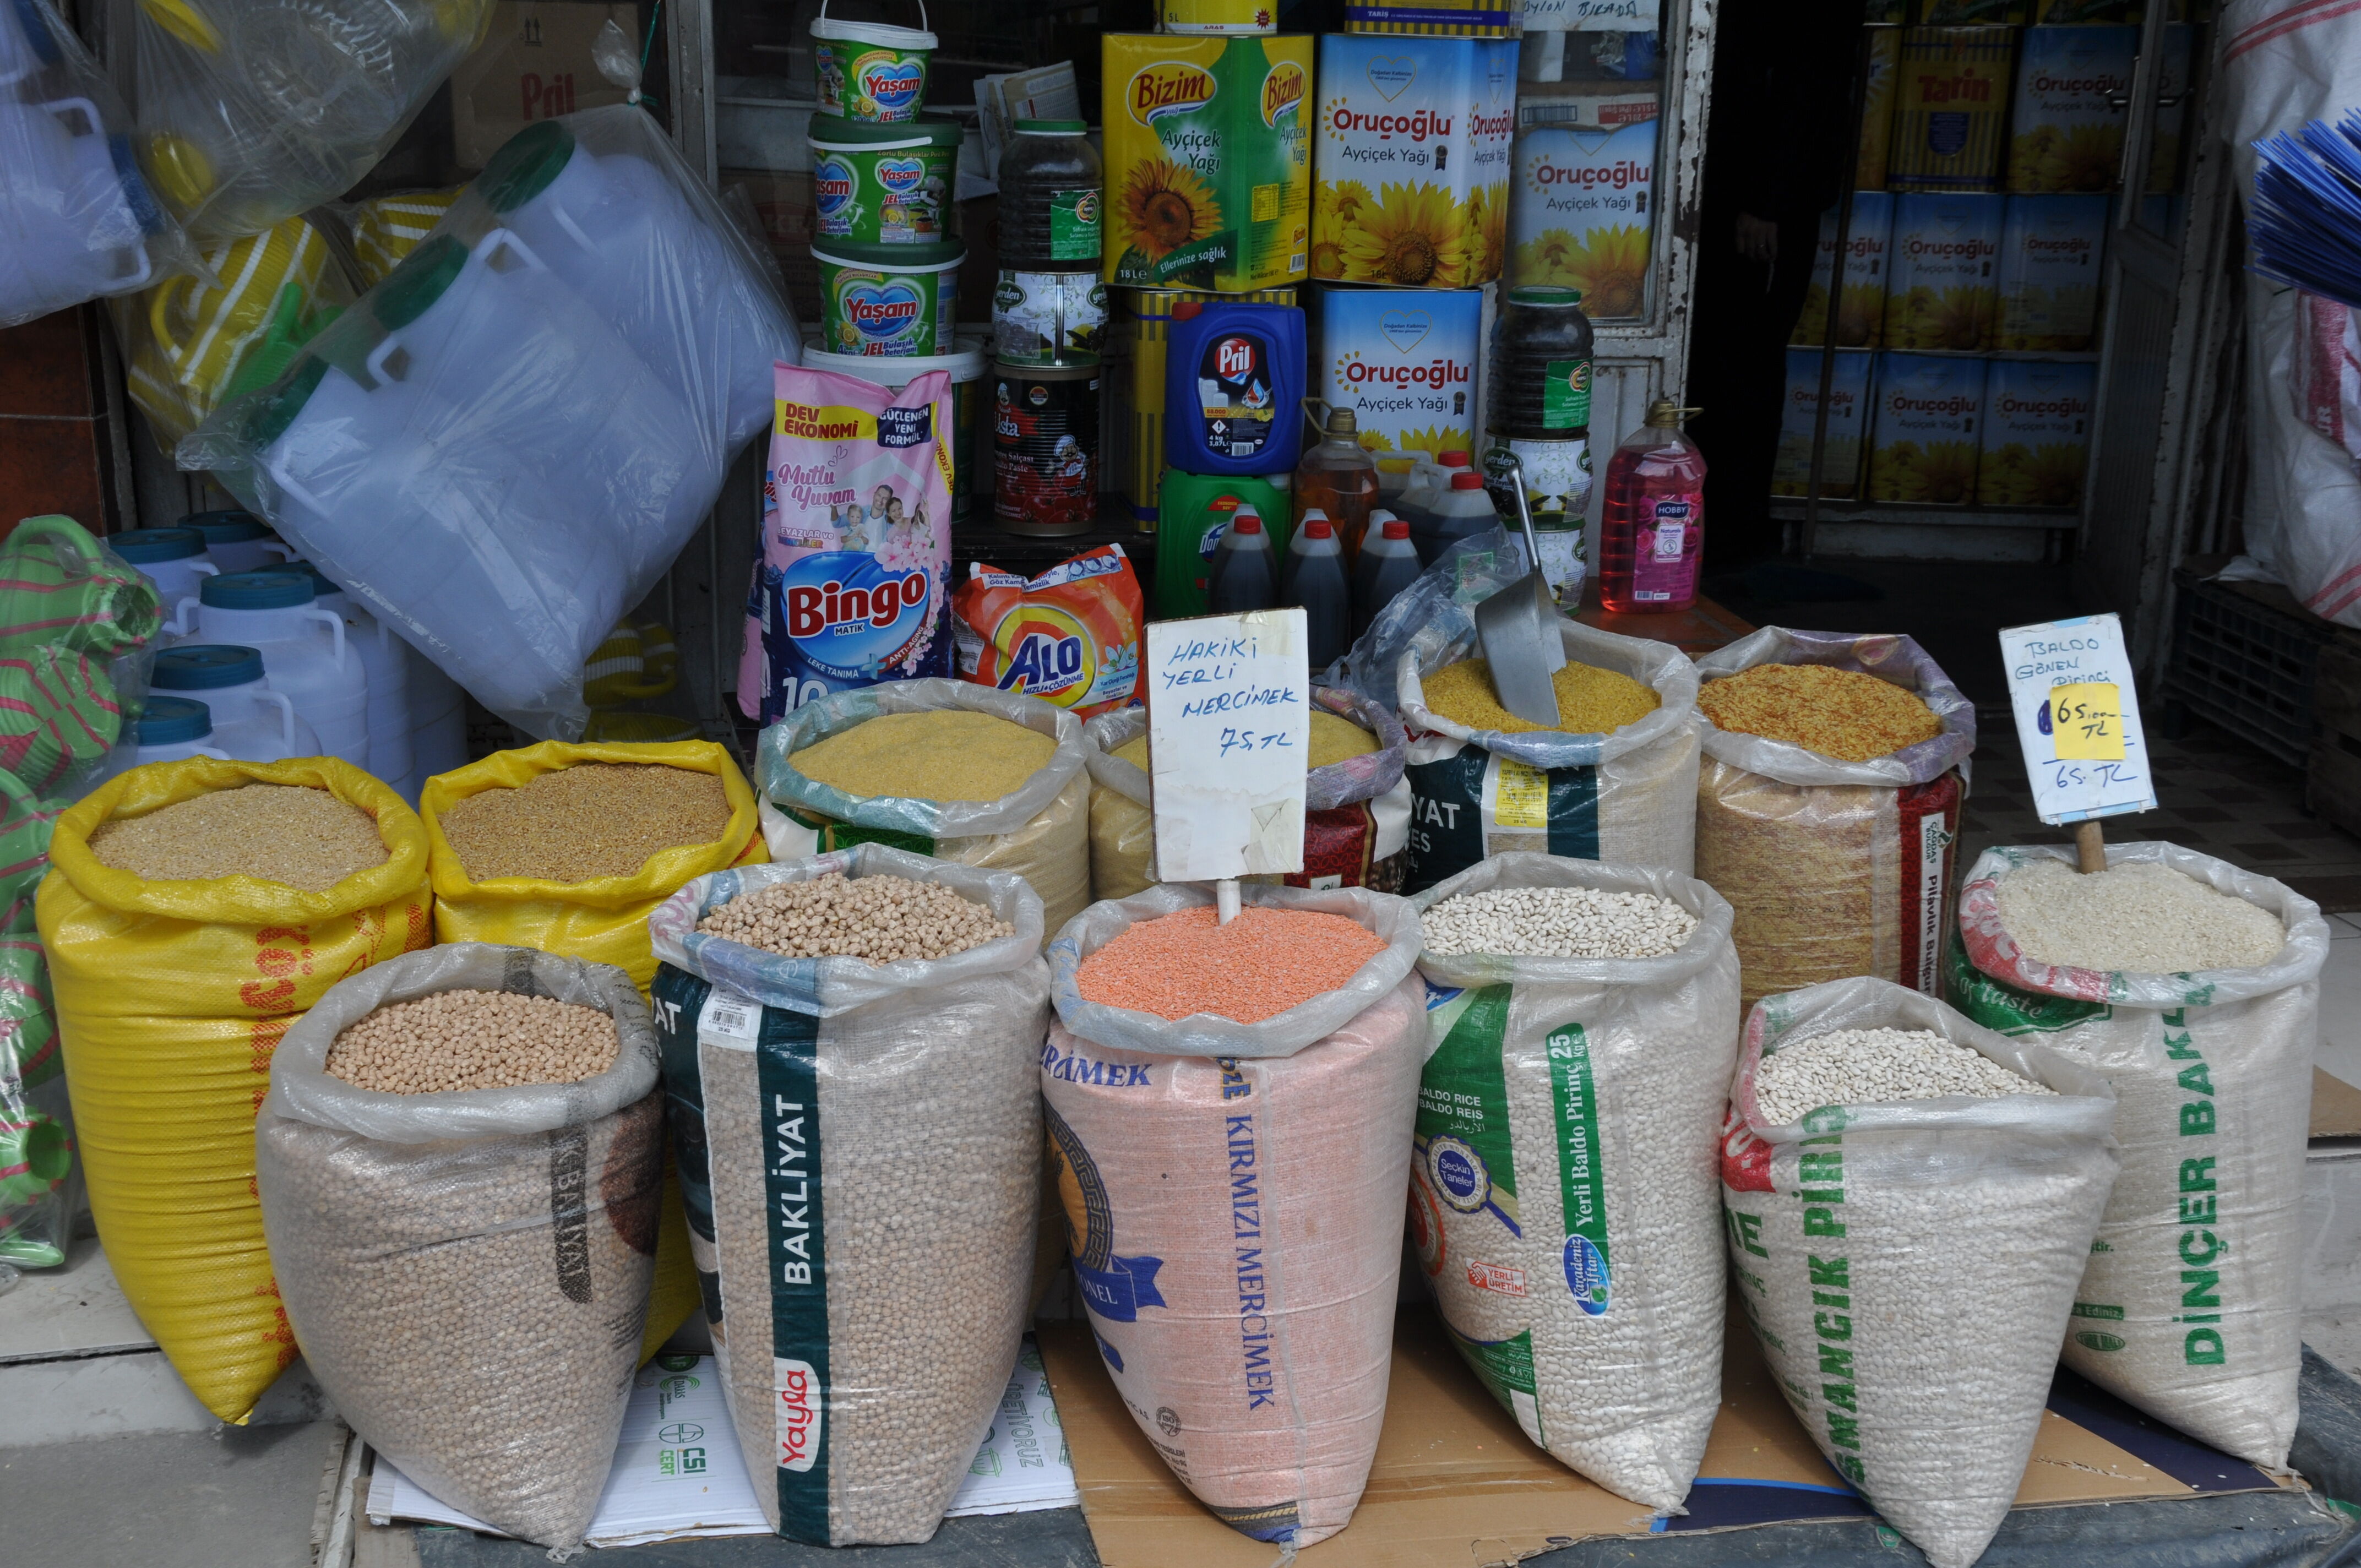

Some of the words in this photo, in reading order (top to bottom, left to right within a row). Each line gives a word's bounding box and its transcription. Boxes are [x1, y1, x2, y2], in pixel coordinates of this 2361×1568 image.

[521, 72, 574, 121] Pril
[865, 74, 921, 97] Yaşam
[1136, 70, 1206, 109] Bizim
[1267, 70, 1302, 111] Bizim
[1280, 122, 1307, 142] Ayçiçek
[1334, 108, 1452, 142] Oruçoğlu
[1472, 109, 1514, 141] Oruçoğlu
[1162, 129, 1221, 151] Ayçiçek
[1189, 153, 1221, 175] Yağı
[1292, 146, 1307, 166] Yağı
[1342, 145, 1396, 163] Ayçiçek
[1400, 149, 1430, 166] Yağı
[879, 167, 920, 183] Yaşam
[1536, 161, 1650, 190] Oruçoğlu
[815, 180, 851, 200] aşam
[883, 193, 899, 204] JEL
[1546, 197, 1598, 213] Ayçiçek
[1602, 196, 1631, 210] Yağı
[1910, 239, 1994, 259] Oruçoğlu
[2028, 238, 2091, 253] Oruçoğlu
[1160, 253, 1196, 274] Ellerinize
[1198, 246, 1227, 263] sağlık
[846, 297, 918, 324] Yaşam
[863, 342, 884, 356] JEL
[883, 337, 914, 349] Bulaşık
[1220, 345, 1251, 373] Pril
[1346, 360, 1470, 390] Oruçoğlu
[785, 402, 821, 422] DEV
[880, 406, 928, 422] GÜÇLENEN
[1357, 396, 1413, 412] Ayçiçek
[1418, 397, 1448, 412] Yağı
[1894, 396, 1977, 416] Oruçoğlu
[2003, 398, 2087, 417] Oruçoğlu
[784, 420, 859, 439] EKONOMİ
[895, 423, 916, 433] YENİ
[777, 464, 836, 487] Mutlu
[791, 484, 858, 511] Yuvam
[1658, 505, 1688, 514] HOBBY
[788, 572, 927, 638] Bingo
[1168, 637, 1258, 666] HAKİKİ
[2024, 637, 2100, 658] BALDO
[807, 657, 825, 672] LEKE
[828, 667, 859, 678] TANIMA
[995, 635, 1081, 690] ALO
[1162, 663, 1235, 689] YERLİ
[1182, 684, 1299, 718] MERCİMEK
[2081, 720, 2109, 740] TL
[1549, 1034, 1571, 1059] 25
[1454, 1095, 1481, 1106] RICE
[1563, 1064, 1586, 1121] Pirinç
[1419, 1098, 1452, 1115] BALDO
[1456, 1107, 1484, 1119] REIS
[1569, 1125, 1590, 1179] Baldo
[1226, 1114, 1261, 1239] KIRMIZI
[1441, 1158, 1471, 1175] Seçkin
[771, 1093, 812, 1285] BAKLİYAT
[1440, 1170, 1473, 1188] Taneler
[1574, 1179, 1593, 1231] Yerli
[1574, 1237, 1592, 1305] Karadeniz
[2172, 1156, 2228, 1365] DİNÇER
[1488, 1268, 1514, 1282] YERLİ
[1488, 1277, 1522, 1293] ÜRETİM
[1236, 1247, 1275, 1411] MERCİMEK
[781, 1369, 813, 1465] Yayla
[1162, 1414, 1174, 1424] ISO
[660, 1449, 675, 1476] CERT
[683, 1447, 706, 1474] CSI
